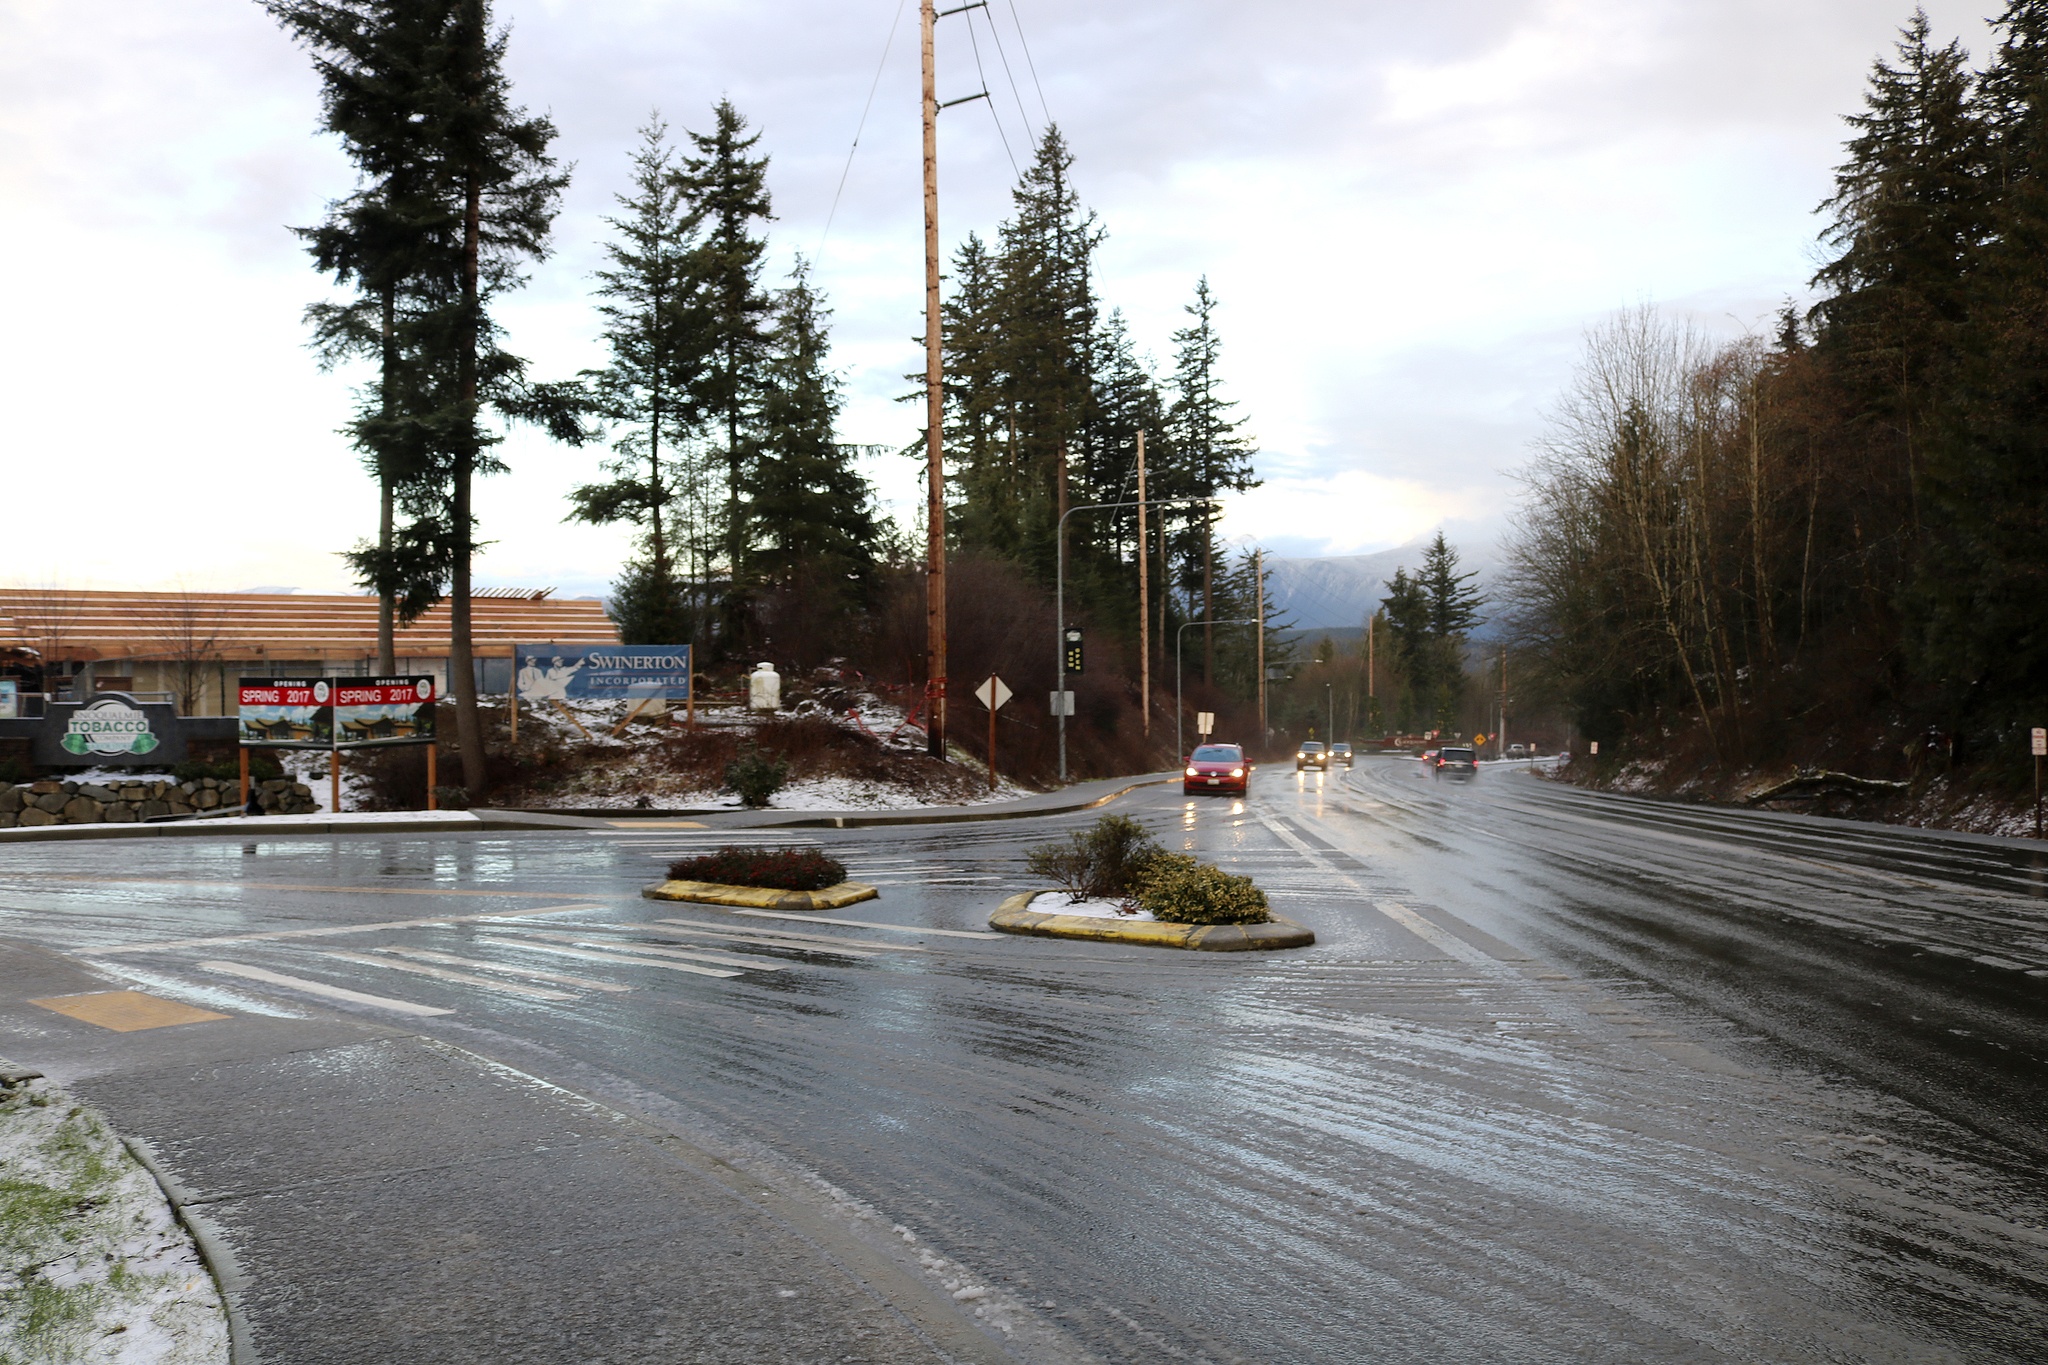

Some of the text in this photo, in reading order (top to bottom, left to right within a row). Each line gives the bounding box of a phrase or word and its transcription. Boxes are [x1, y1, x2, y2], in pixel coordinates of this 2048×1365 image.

[588, 652, 687, 670] SWINERTON
[273, 680, 307, 688] OPENING
[375, 678, 409, 687] OPENING
[590, 676, 686, 686] INCORPORATED
[241, 689, 280, 703] SPRING
[286, 689, 311, 703] 2017
[339, 689, 382, 704] SPRING
[389, 688, 413, 702] 2017
[70, 721, 147, 733] TOBACCO
